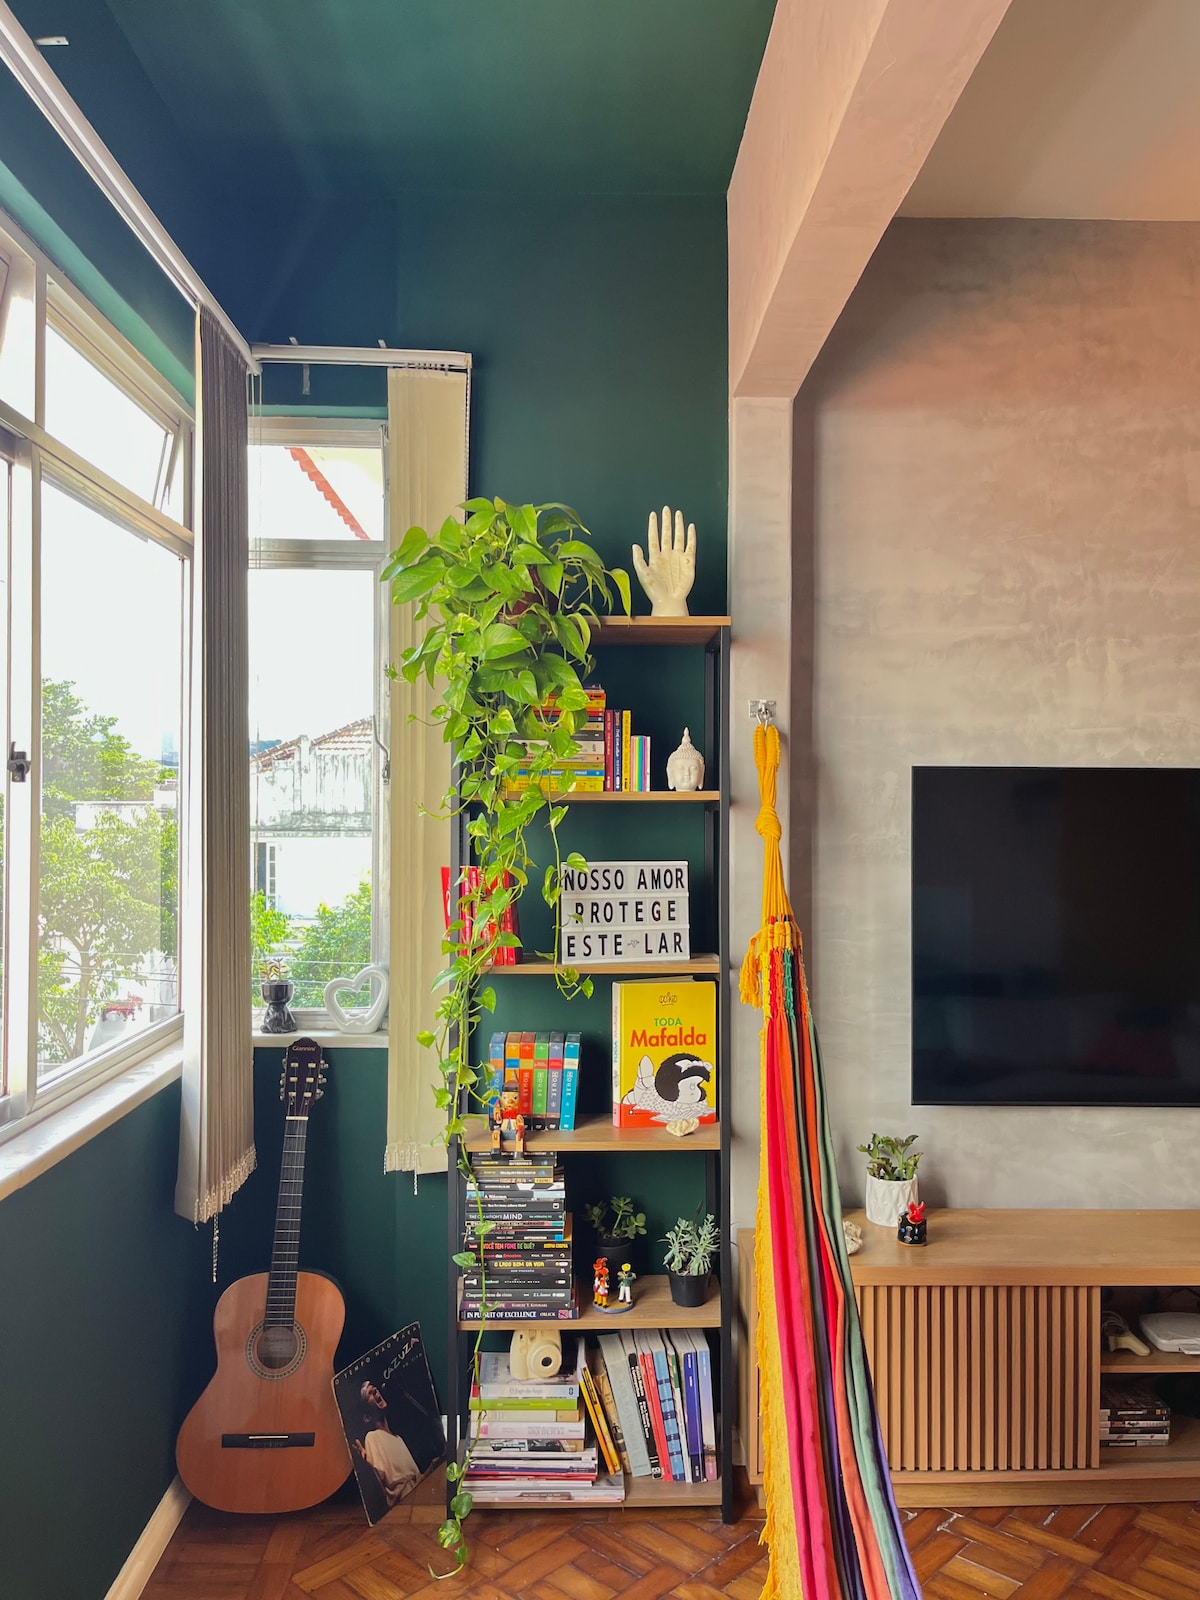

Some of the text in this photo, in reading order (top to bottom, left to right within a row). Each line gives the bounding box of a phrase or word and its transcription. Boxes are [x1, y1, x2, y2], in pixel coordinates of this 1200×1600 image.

[564, 868, 685, 891] NOSSO AMOR
[575, 900, 676, 924] PROTEGE
[567, 932, 683, 957] ESTE LAR
[654, 1017, 682, 1027] TODA
[630, 1027, 707, 1048] Mafalda
[551, 1071, 559, 1097] HOUSE
[566, 1071, 574, 1096] HOUSE
[504, 1242, 517, 1250] FOME
[344, 1357, 371, 1379] TEMPO
[383, 1337, 420, 1380] CAZUZA
